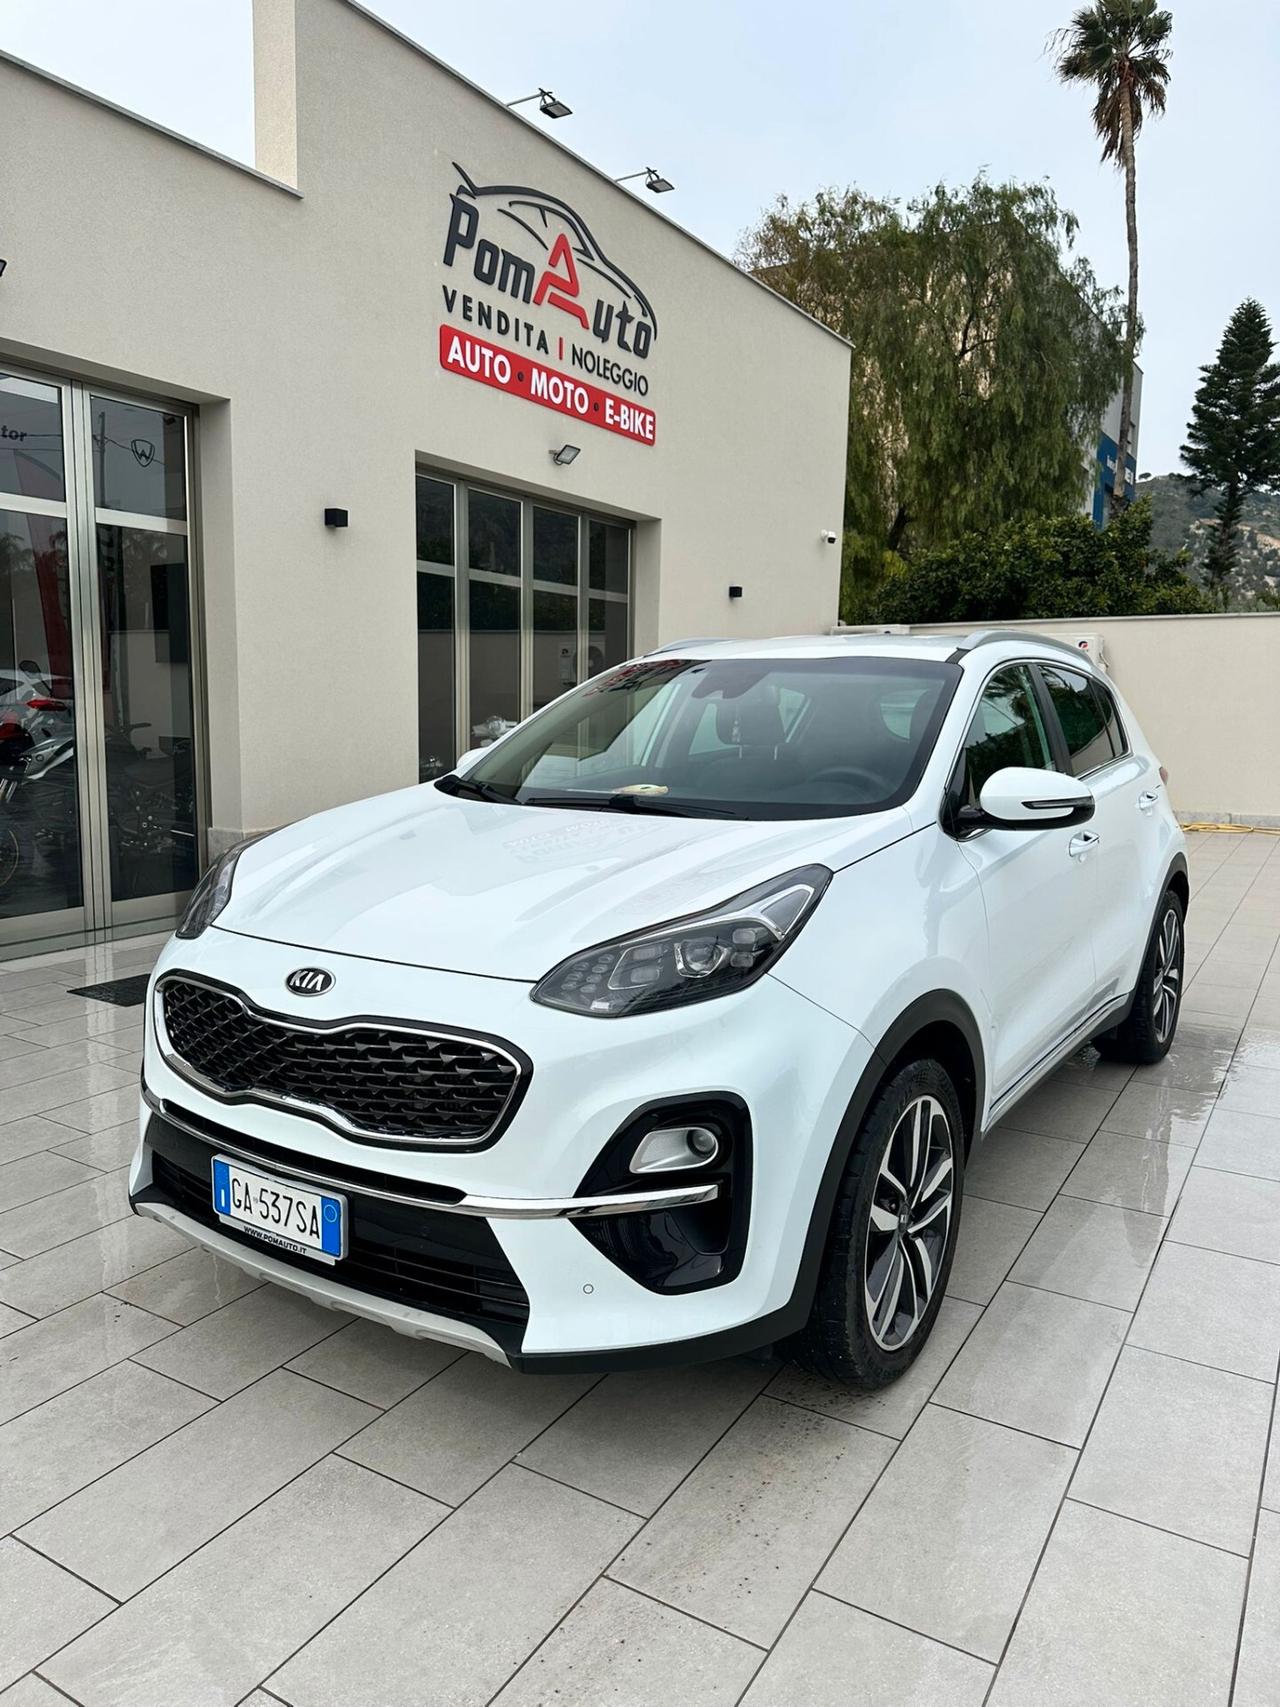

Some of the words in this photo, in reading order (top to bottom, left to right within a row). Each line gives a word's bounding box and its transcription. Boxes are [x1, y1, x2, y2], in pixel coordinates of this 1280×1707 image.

[442, 285, 549, 354] VENDITA
[572, 343, 649, 396] NOLEGGIO
[447, 335, 511, 384] AUTO
[530, 368, 589, 415] MOTO
[605, 398, 654, 440] E-BIKE
[290, 970, 325, 991] KIA
[243, 1225, 307, 1255] WWW.POMAUTO.IT
